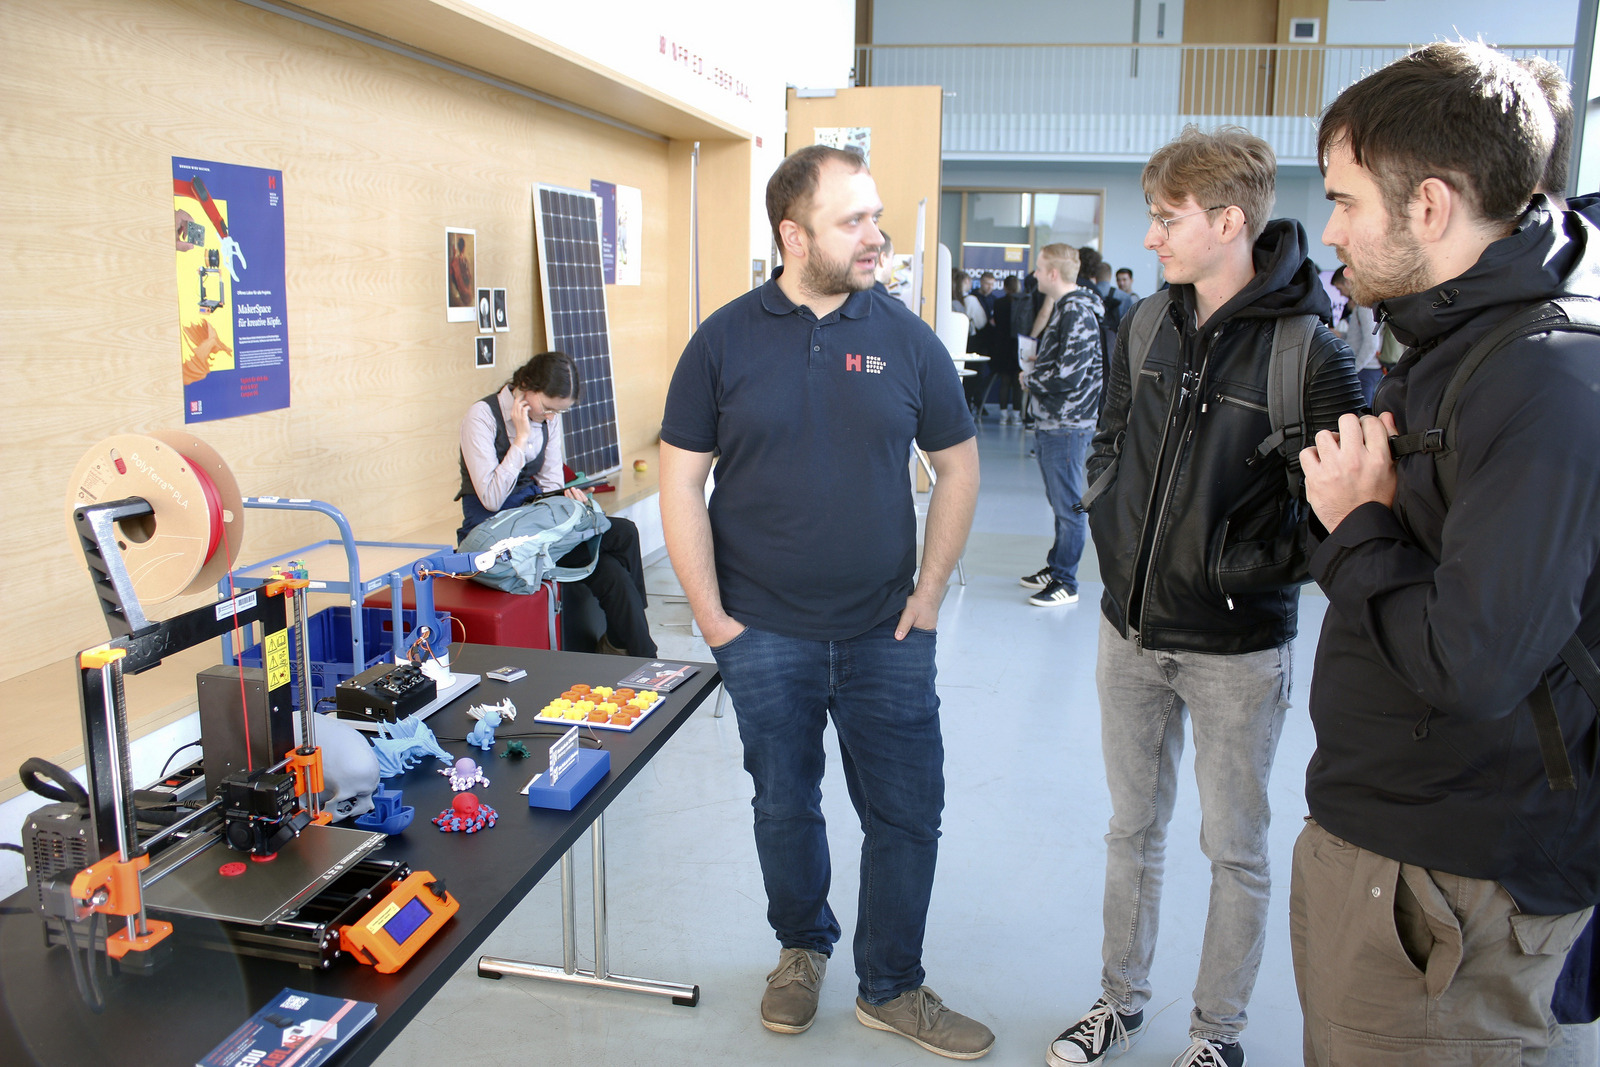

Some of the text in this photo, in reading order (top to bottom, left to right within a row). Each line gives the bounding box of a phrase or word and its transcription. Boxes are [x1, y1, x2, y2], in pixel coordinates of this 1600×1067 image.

[238, 304, 272, 316] MakerSpace
[238, 317, 247, 328] für
[247, 317, 266, 327] kreative
[845, 353, 862, 372] H
[172, 490, 189, 510] PLA
[127, 631, 176, 663] RUSA
